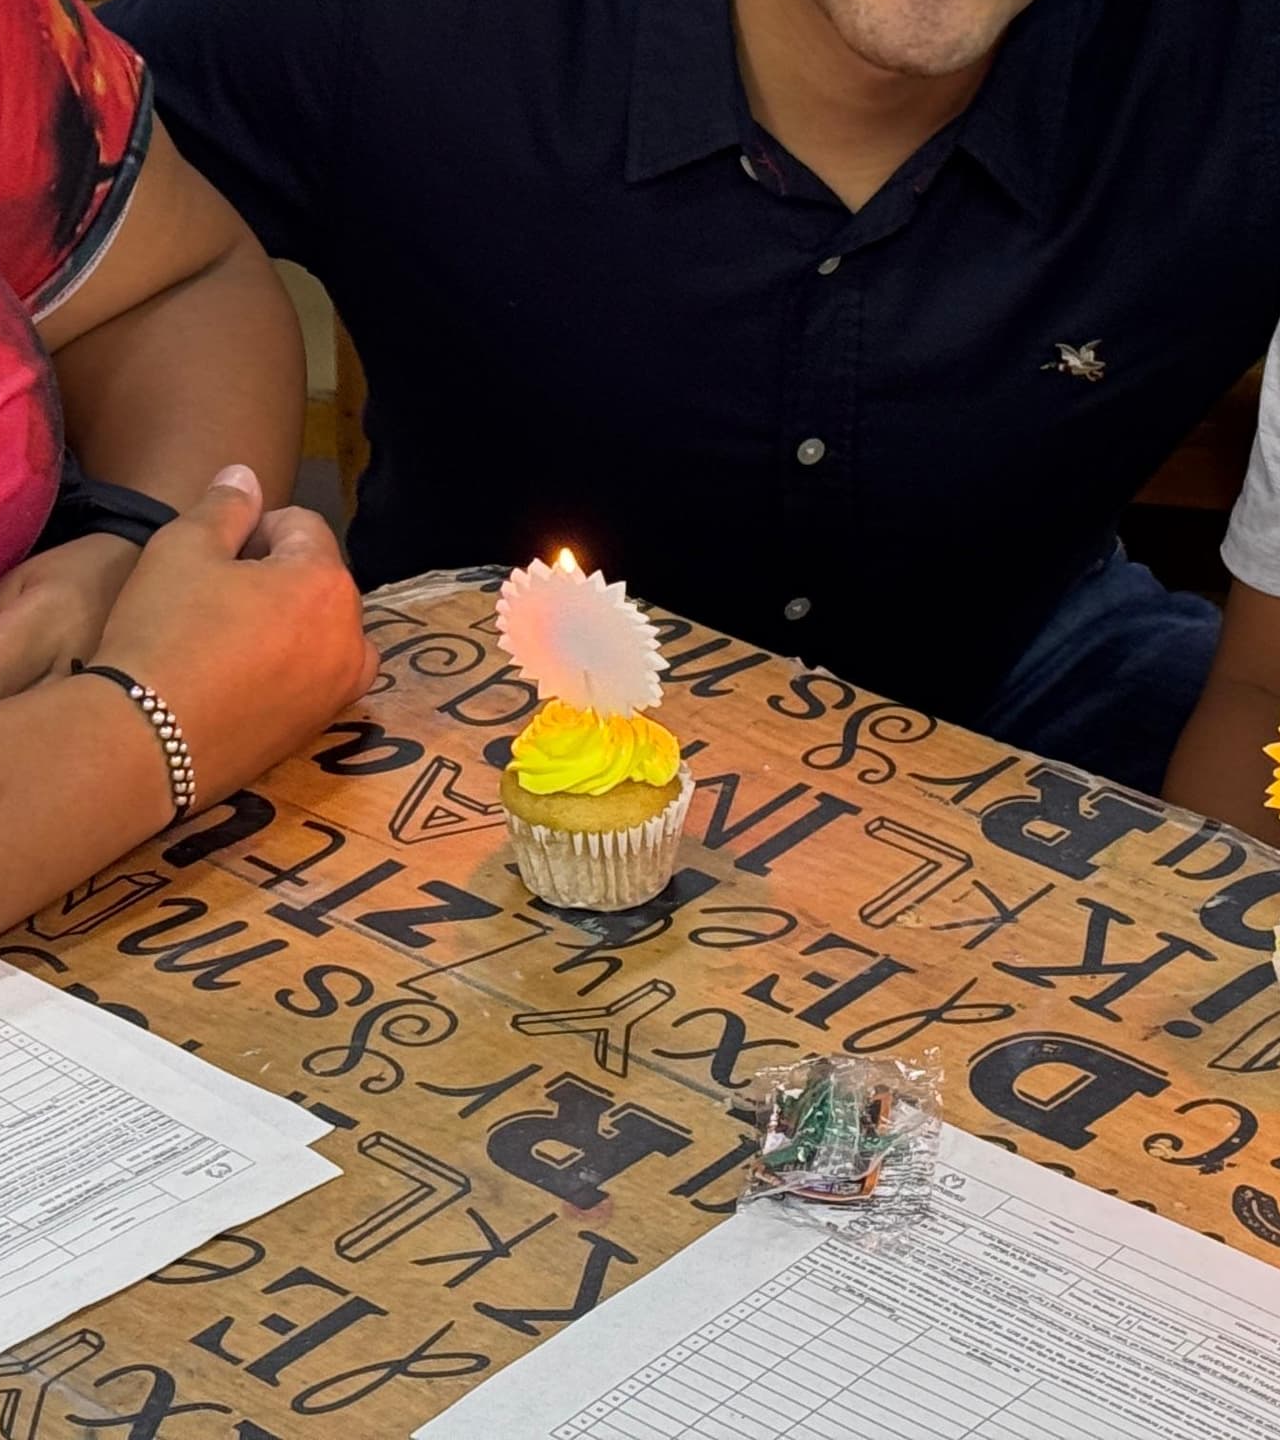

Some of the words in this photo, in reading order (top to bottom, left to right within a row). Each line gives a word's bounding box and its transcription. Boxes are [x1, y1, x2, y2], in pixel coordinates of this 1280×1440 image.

[859, 816, 973, 928] L
[981, 763, 1166, 880] R
[743, 933, 916, 1031] E
[992, 898, 1218, 1022] K
[486, 1071, 694, 1210] R
[968, 1030, 1172, 1150] D
[335, 1131, 471, 1262] L
[190, 1266, 388, 1387] E
